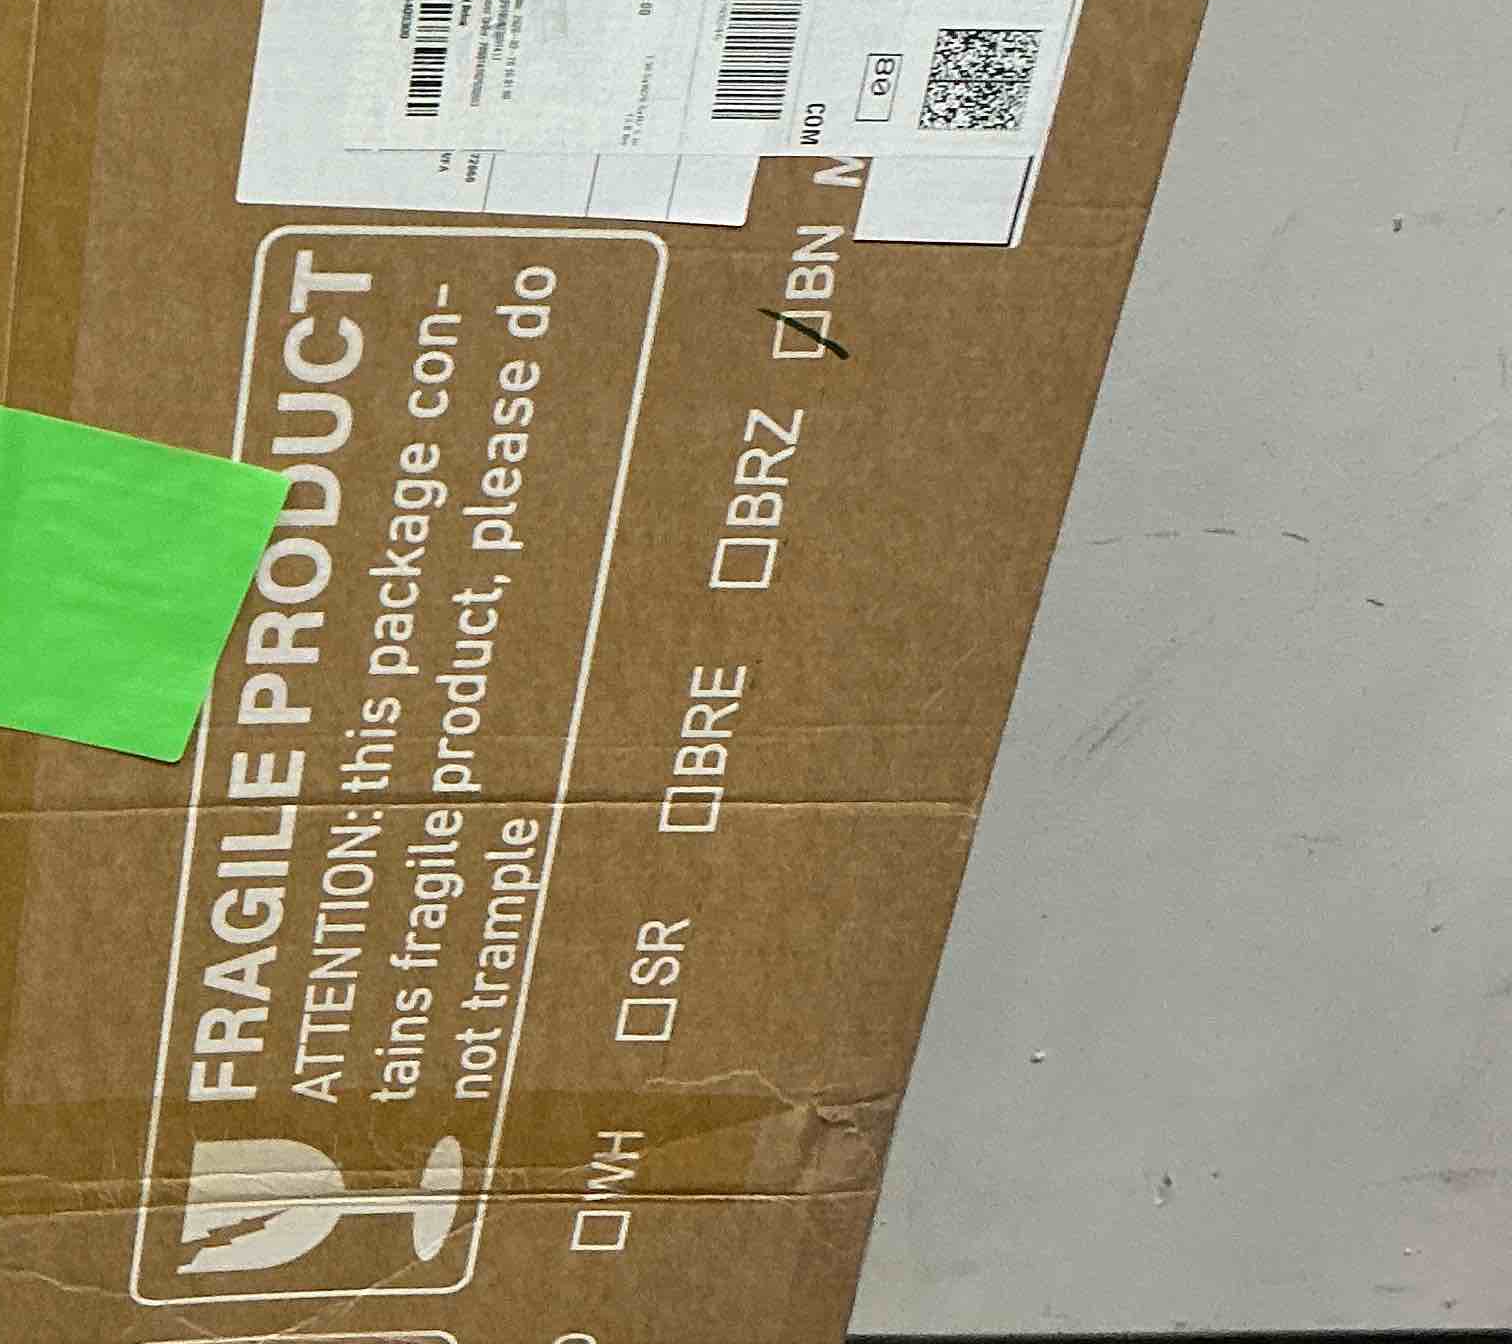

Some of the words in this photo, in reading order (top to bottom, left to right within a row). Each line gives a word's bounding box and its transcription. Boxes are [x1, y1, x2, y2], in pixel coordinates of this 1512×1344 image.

[800, 103, 826, 145] COM
[408, 282, 463, 419] con-
[496, 265, 558, 339] do
[237, 250, 374, 725] PRODUCT
[463, 359, 542, 551] please
[368, 442, 449, 675] package
[341, 696, 402, 794] this
[432, 574, 512, 794] product,
[589, 1130, 647, 1201] WH
[630, 917, 692, 986] SR
[674, 664, 748, 779] BRE
[725, 409, 805, 528] BRZ
[785, 225, 841, 299] BN
[189, 750, 306, 1102] FRAGILE
[292, 810, 385, 1104] ATTENTION:
[391, 810, 466, 969] fragile
[461, 817, 544, 1010] trample
[370, 987, 433, 1103] tains
[455, 1027, 504, 1100] not
